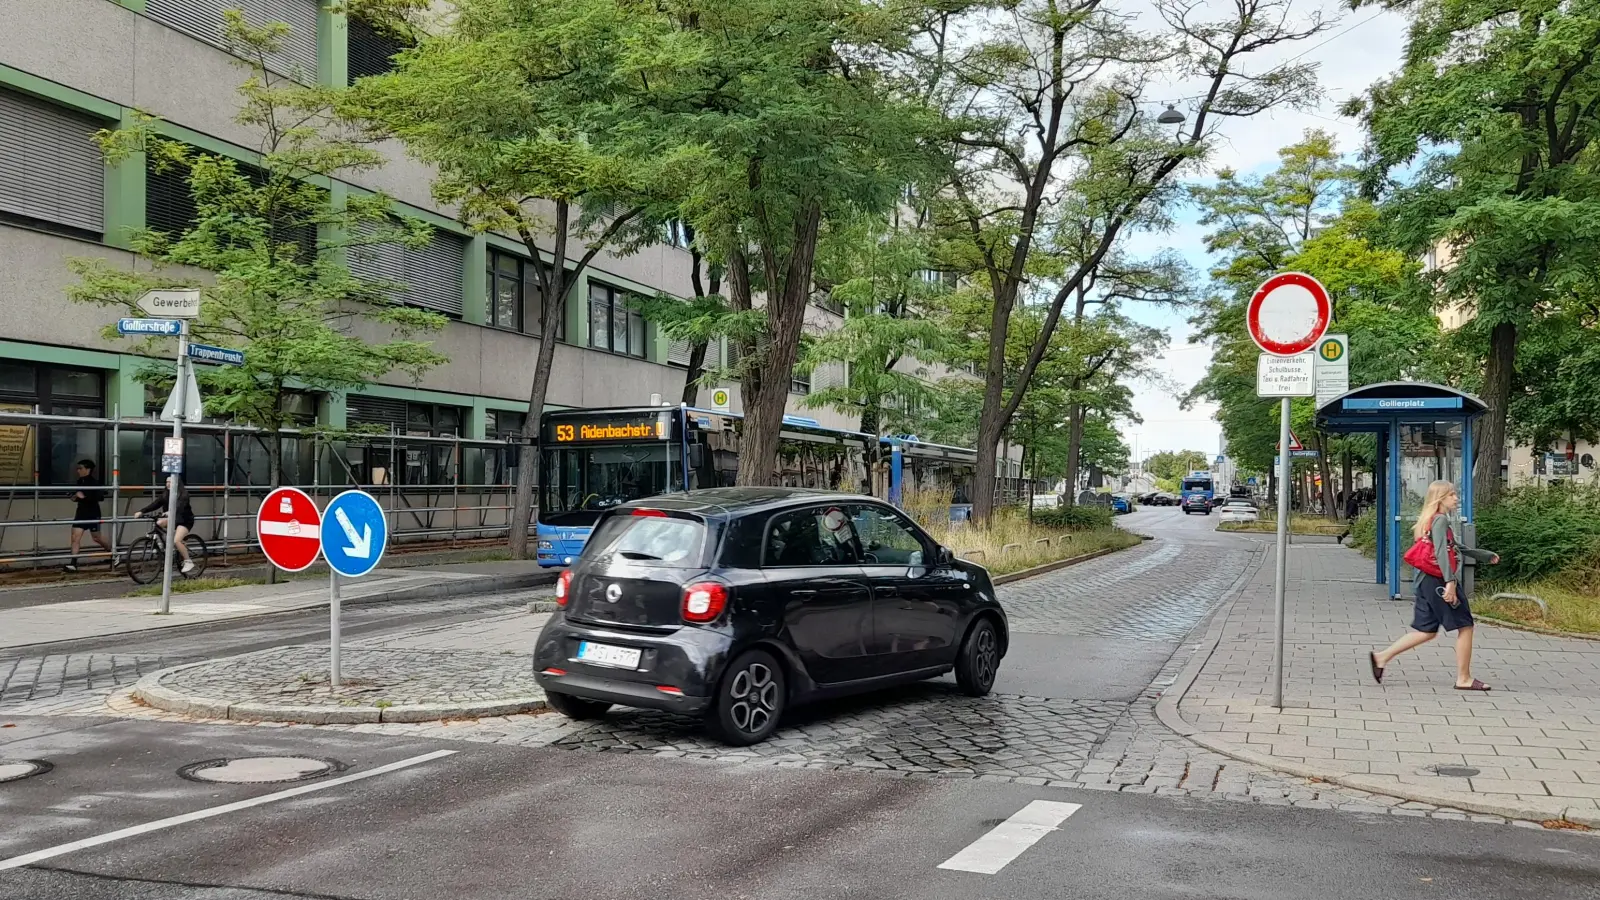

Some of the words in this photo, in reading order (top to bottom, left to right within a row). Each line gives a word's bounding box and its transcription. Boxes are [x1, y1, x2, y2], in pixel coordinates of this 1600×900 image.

[122, 320, 175, 334] Gollierstraße
[1278, 384, 1291, 392] frei
[1379, 399, 1425, 408] Gollierplatz
[557, 425, 575, 442] 53
[580, 422, 654, 440] Aidenbachstr.
